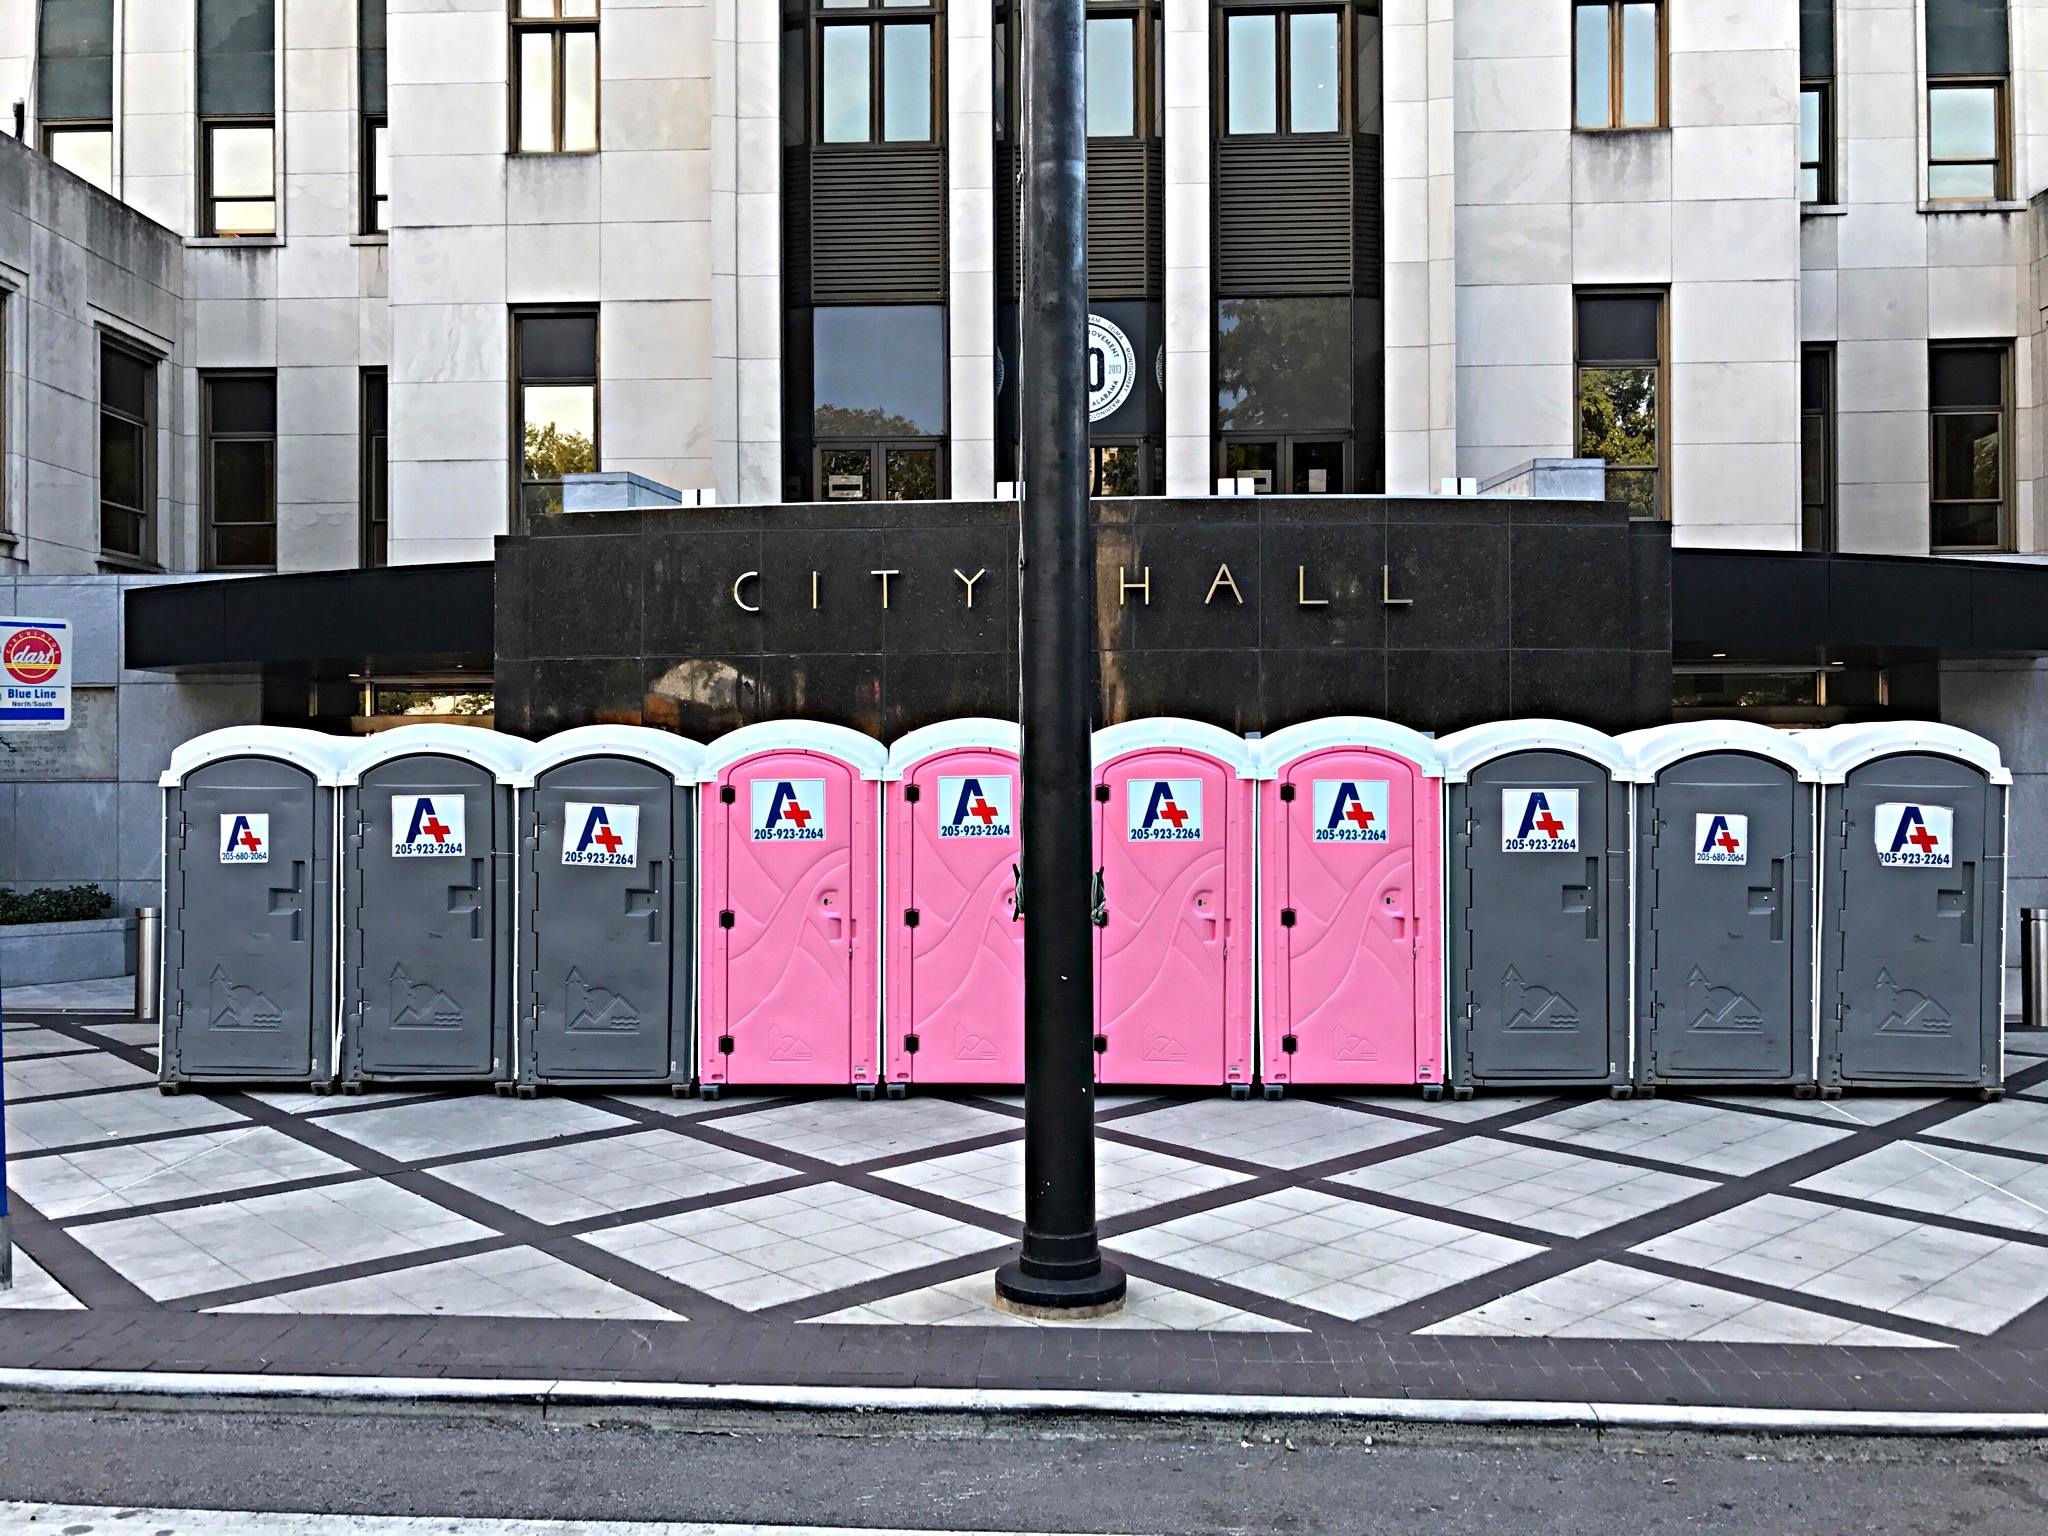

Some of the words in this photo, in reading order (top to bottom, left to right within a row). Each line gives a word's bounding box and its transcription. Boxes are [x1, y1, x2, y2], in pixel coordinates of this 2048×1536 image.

[1108, 324, 1124, 340] SELMA
[1089, 329, 1120, 358] OVEMENT
[1108, 364, 1122, 375] 2013
[1123, 347, 1135, 392] MONTGOMERY
[1092, 380, 1118, 406] ALABAMA
[1089, 399, 1121, 420] WASHINGTO
[733, 568, 986, 611] CITY
[1119, 563, 1413, 605] HALL
[6, 630, 60, 655] CIRCULATOR
[13, 645, 55, 664] dart
[8, 689, 31, 699] Blue
[34, 689, 57, 699] Line
[754, 828, 824, 840] 205-923-2264
[941, 825, 1010, 837] 205-923-2264
[1131, 828, 1201, 840] 205-923-2264
[1316, 829, 1386, 841] 205-923-2264
[395, 843, 463, 855] 205-923-2264
[1506, 838, 1576, 850] 205-923-2264
[222, 852, 267, 860] 205-680-2064
[565, 851, 634, 865] 205-923-2264
[1697, 852, 1745, 862] 205-680-2064
